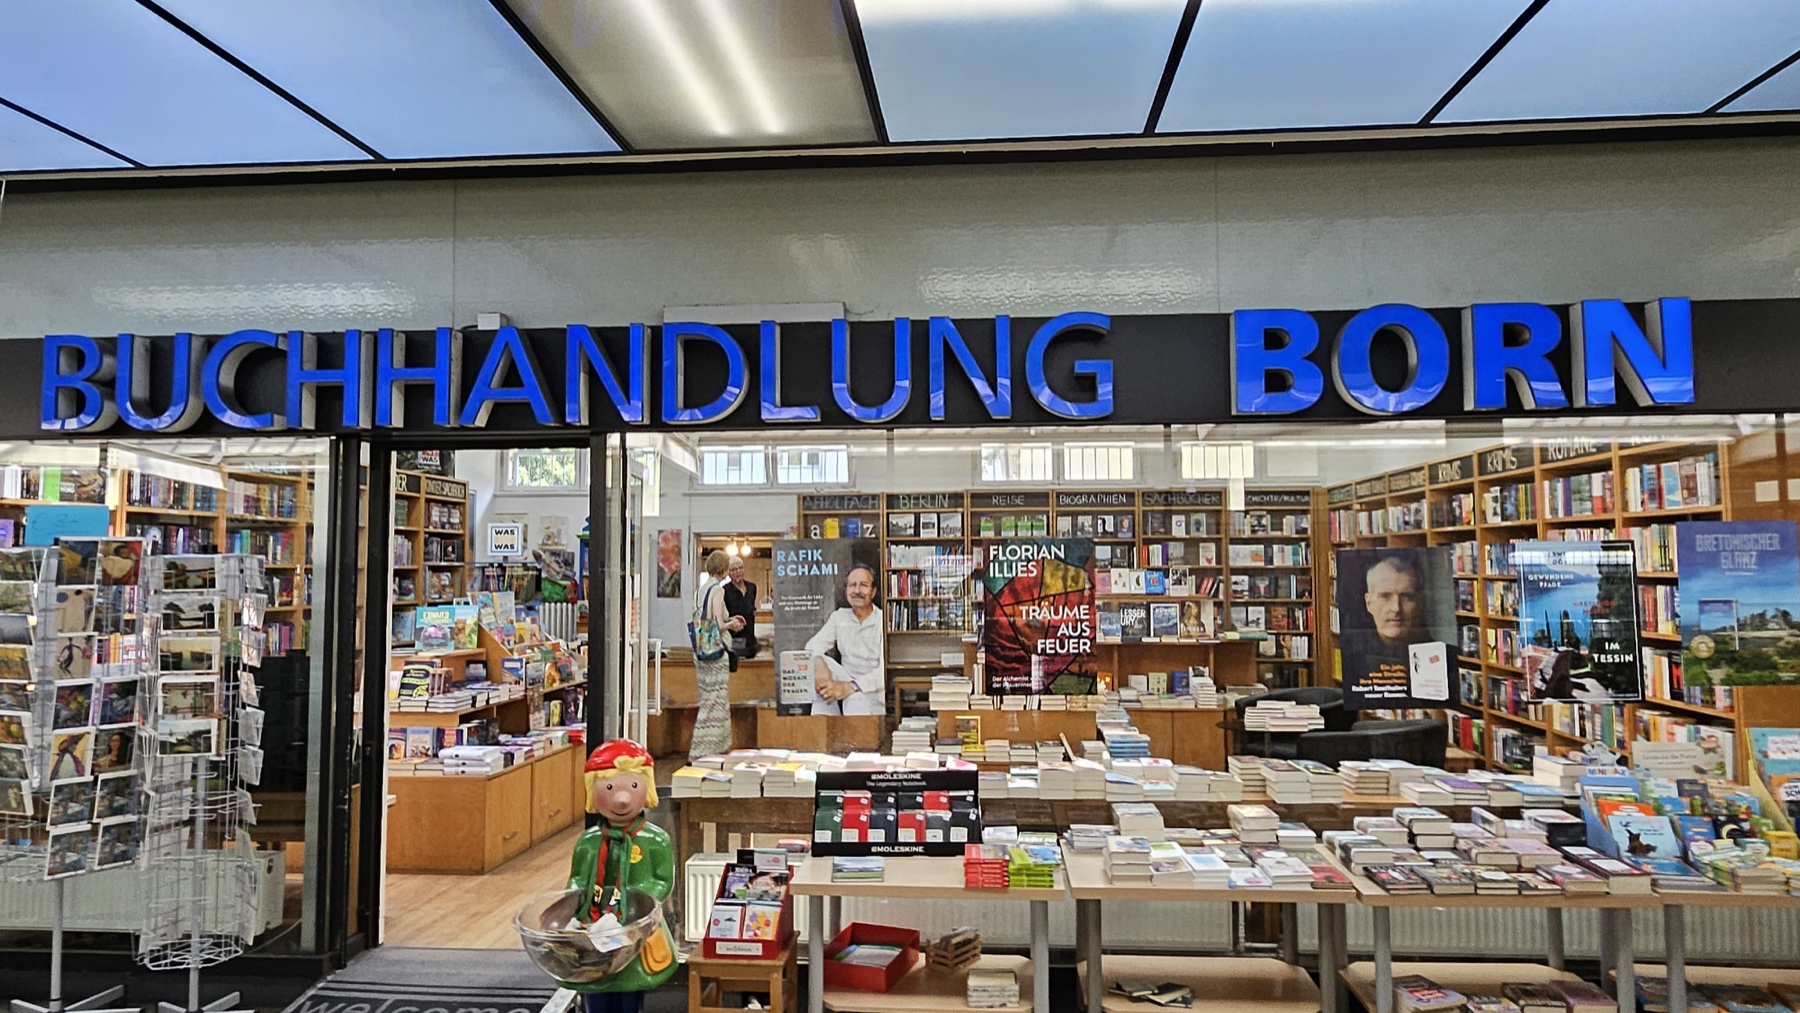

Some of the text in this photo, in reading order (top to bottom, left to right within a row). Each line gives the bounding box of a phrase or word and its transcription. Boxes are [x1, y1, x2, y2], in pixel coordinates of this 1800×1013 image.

[41, 297, 1695, 432] BUCHHANDLUNG BORN
[1487, 446, 1518, 473] KRIMIS
[1438, 460, 1461, 483] KRIMIS
[900, 494, 949, 508] BERLIN
[992, 495, 1025, 506] REISE
[1059, 494, 1127, 505] BIOGRAPHIEN
[777, 549, 823, 562] RAFIK
[989, 544, 1065, 560] FLORIAN
[777, 563, 838, 576] SCHAMI
[989, 562, 1038, 578] ILLIES
[1020, 601, 1090, 619] TRÄUME
[1120, 608, 1146, 619] LESSER
[1057, 622, 1091, 636] AUS
[1037, 639, 1091, 653] FEUER
[1605, 641, 1620, 650] IM
[1592, 654, 1633, 663] TESSIN
[876, 845, 925, 853] MOLESKINE
